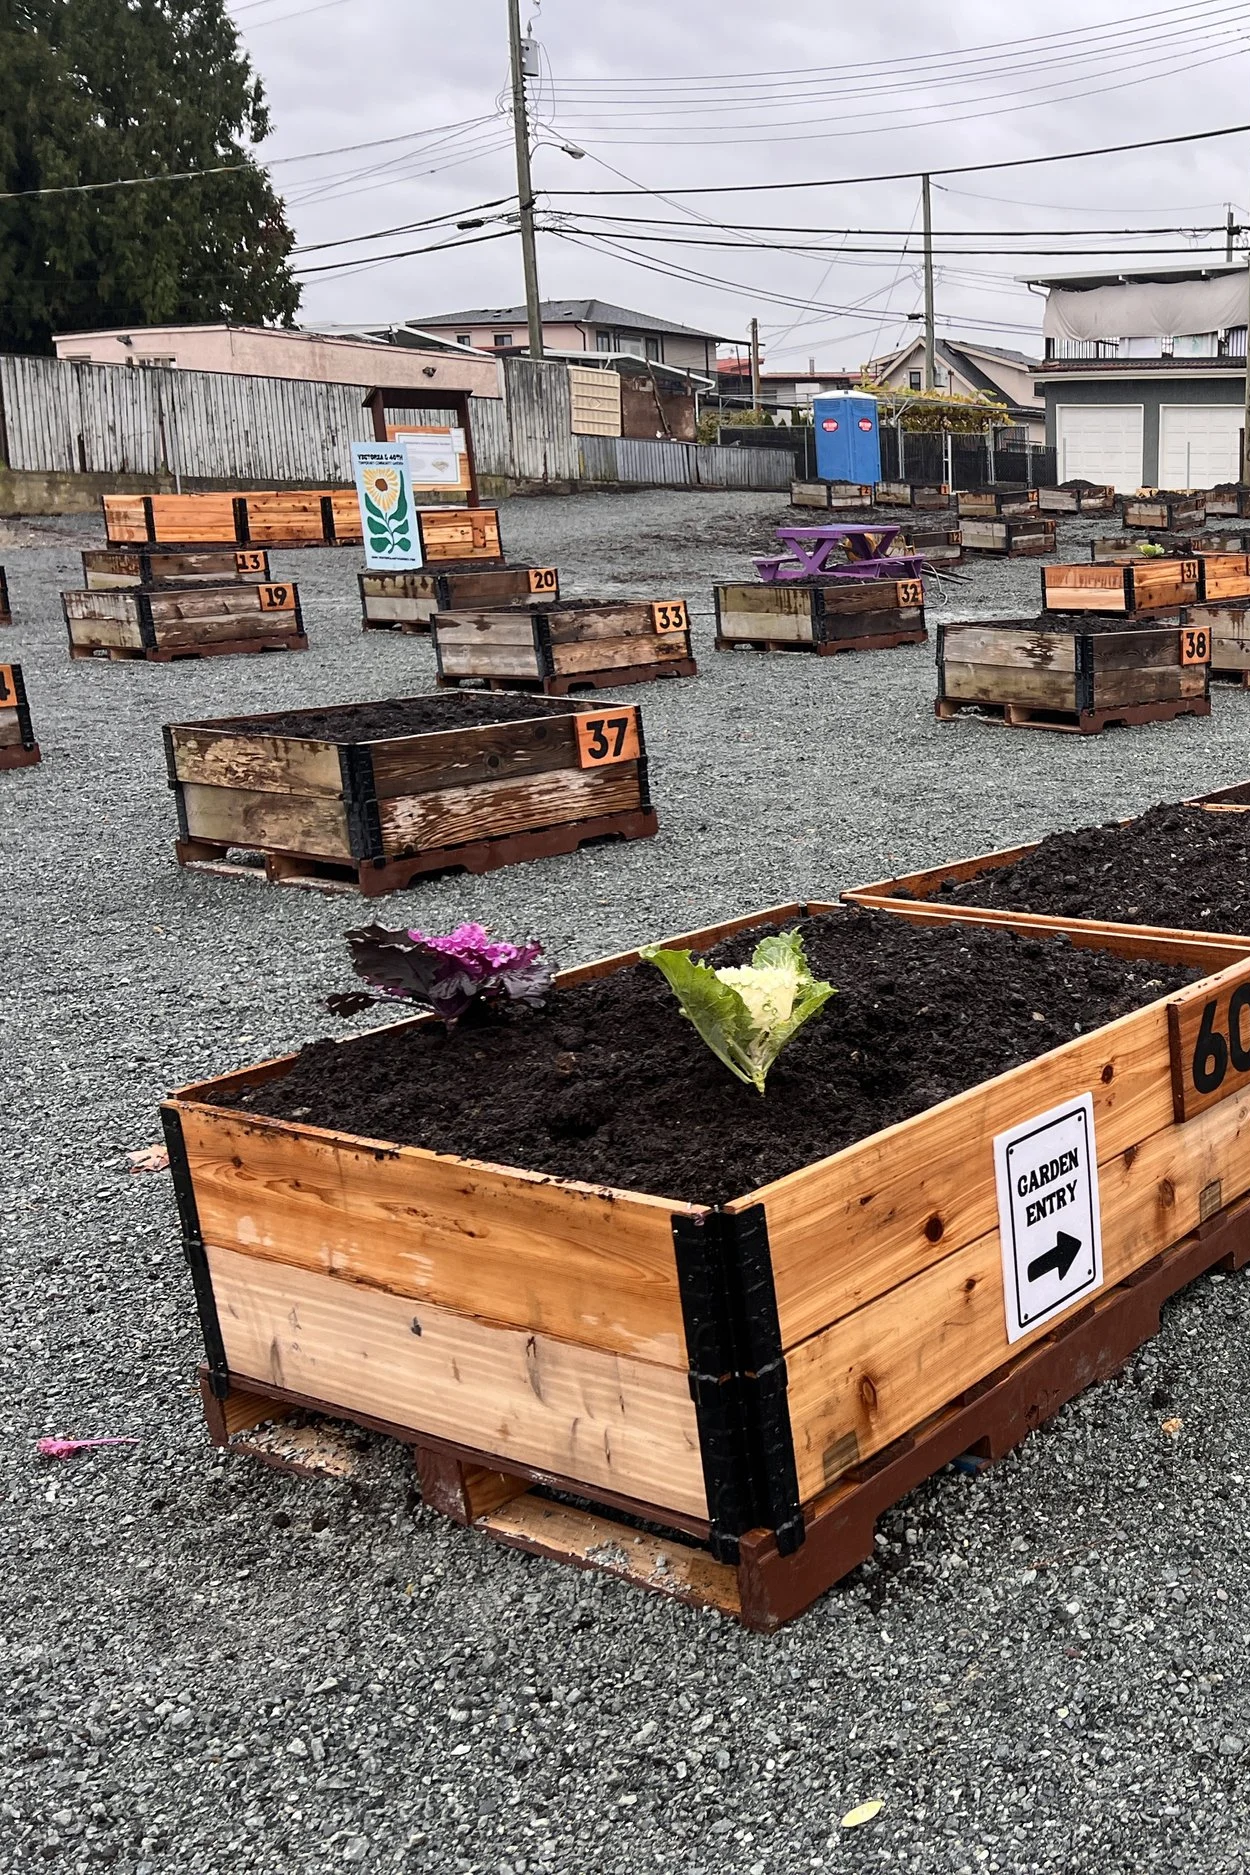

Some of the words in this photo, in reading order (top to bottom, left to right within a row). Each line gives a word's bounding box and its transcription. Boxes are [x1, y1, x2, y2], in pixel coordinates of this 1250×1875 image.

[238, 554, 260, 569] 13
[1185, 562, 1197, 579] 31
[533, 571, 555, 589] 20
[265, 586, 287, 607] 19
[901, 584, 918, 603] 32
[657, 606, 683, 629] 33
[1186, 632, 1207, 658] 38
[586, 717, 628, 759] 37
[1017, 1147, 1079, 1197] GARDEN
[1026, 1179, 1078, 1227] ENTRY
